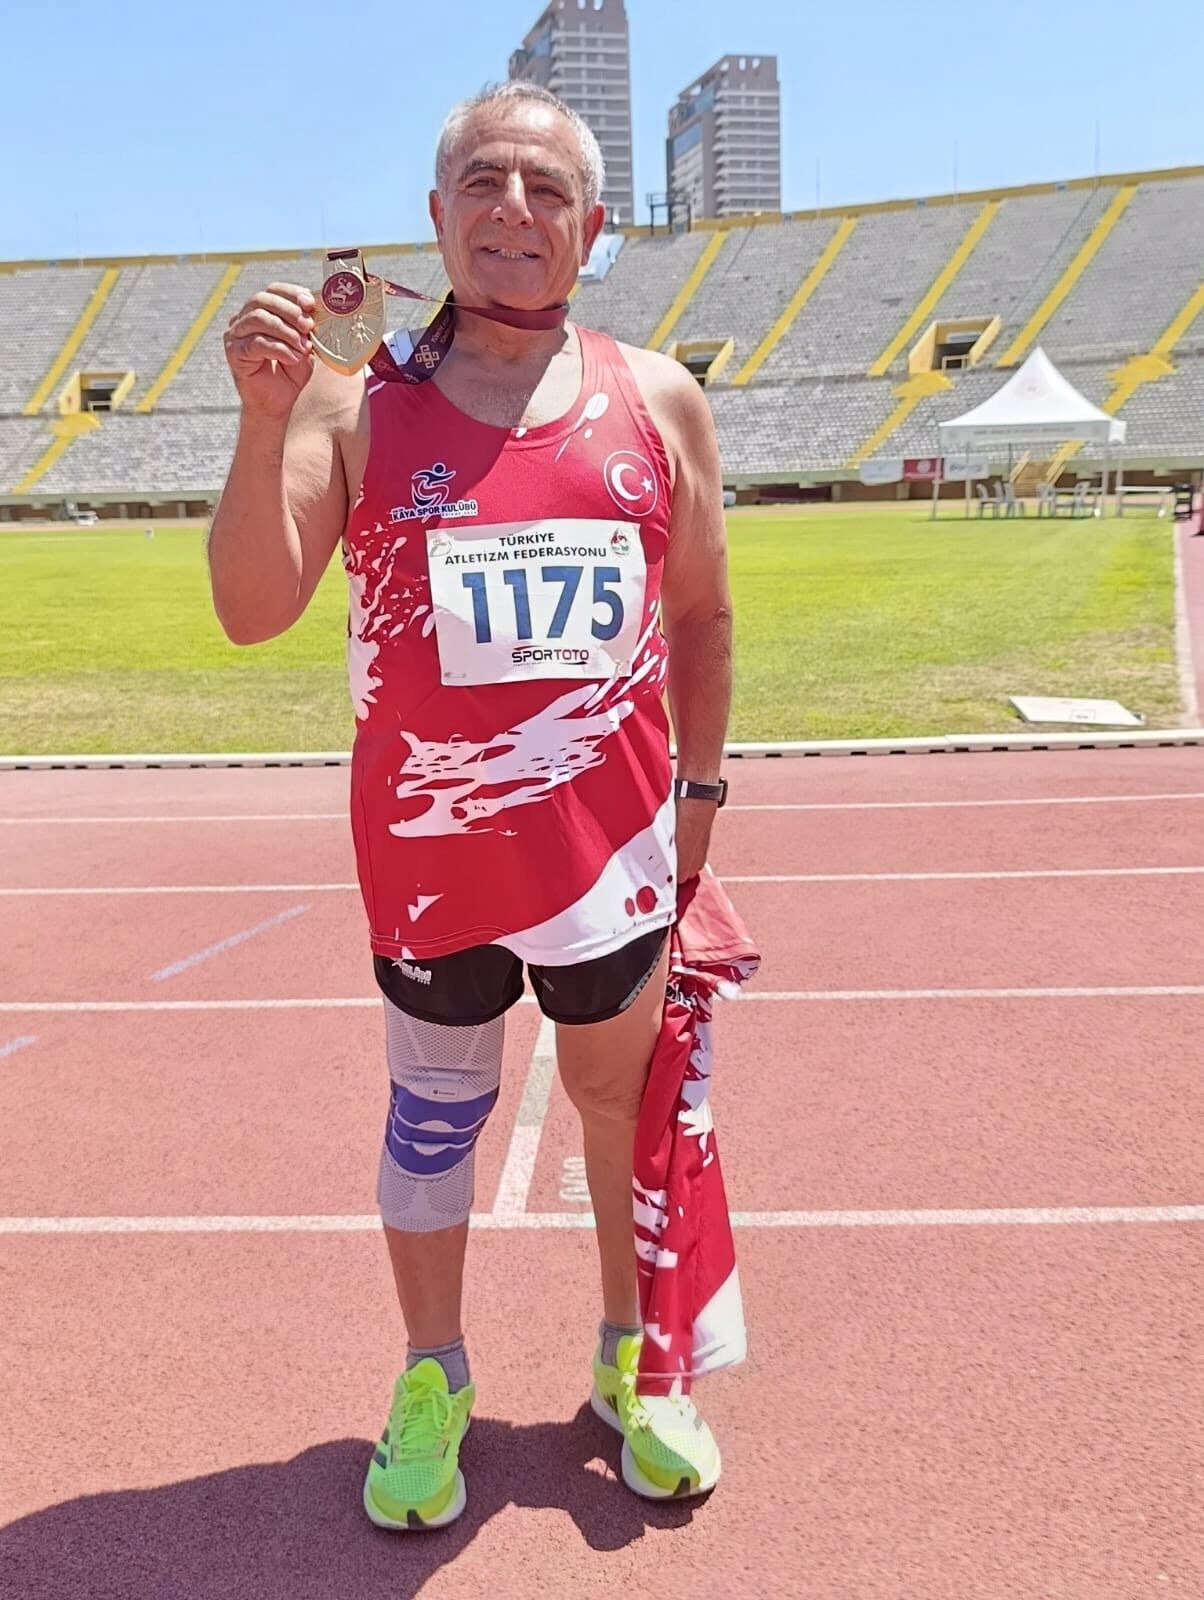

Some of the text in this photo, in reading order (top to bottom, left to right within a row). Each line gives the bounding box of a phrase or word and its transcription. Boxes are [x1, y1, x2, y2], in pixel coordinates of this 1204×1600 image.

[392, 500, 477, 521] KAYA SPOR KULÜBÜ
[498, 531, 555, 547] TÜRKİYE
[444, 546, 607, 566] ATLETİZM FEDERASYONU
[461, 565, 625, 645] 1175
